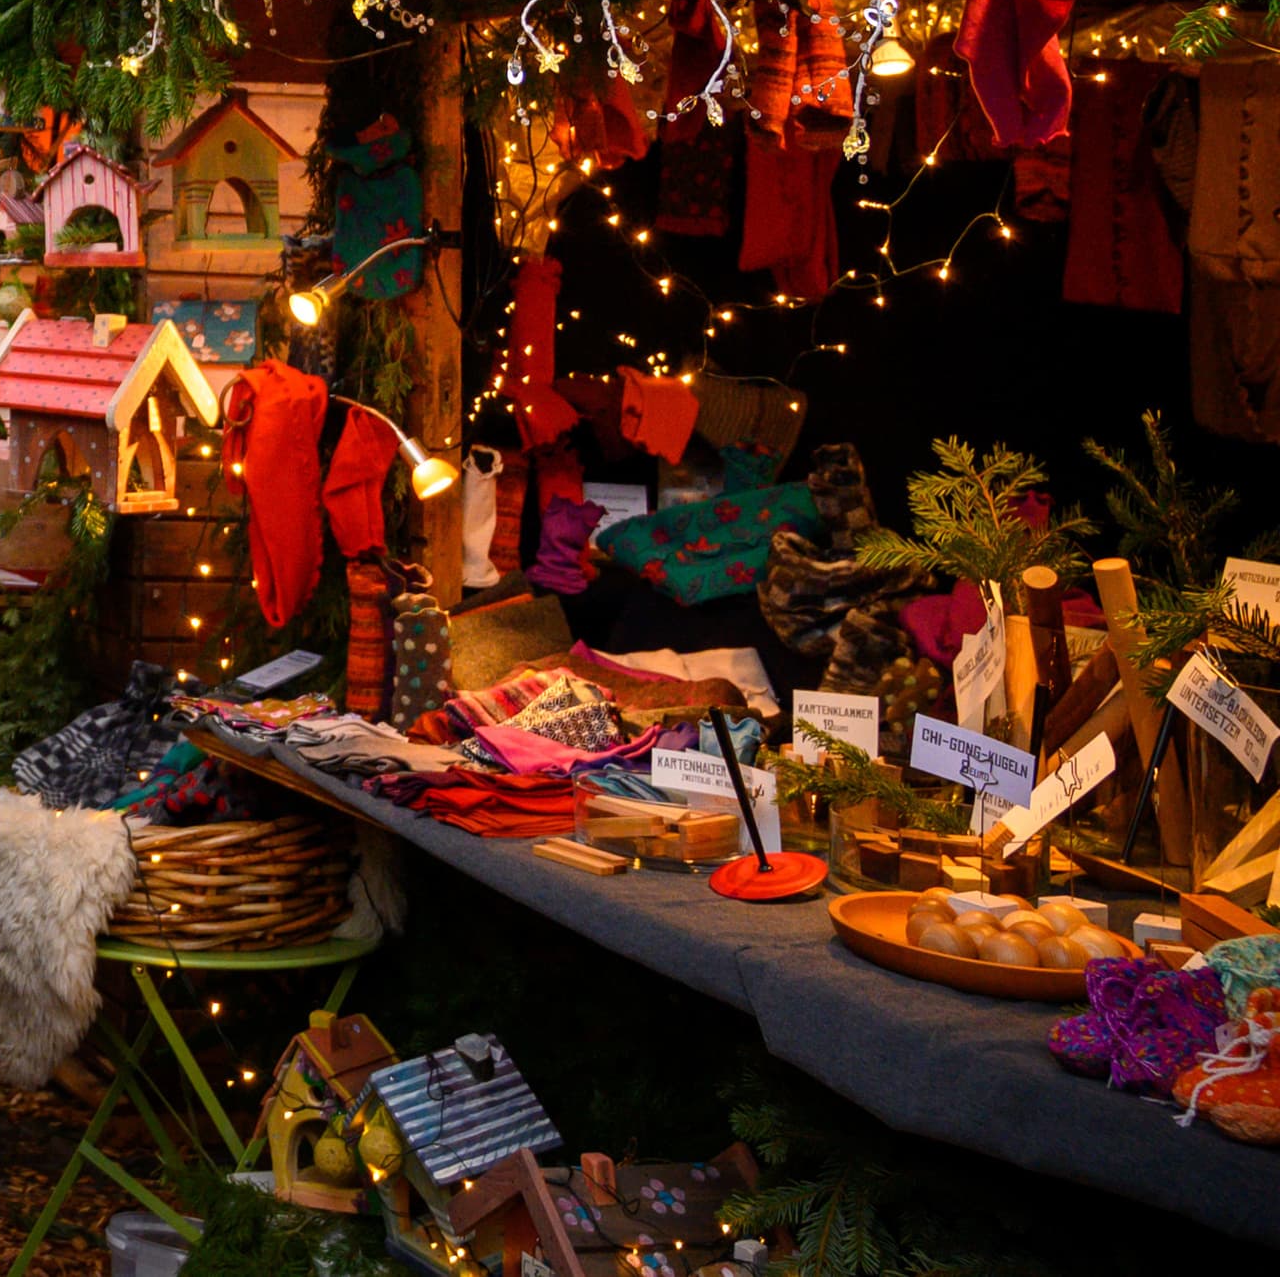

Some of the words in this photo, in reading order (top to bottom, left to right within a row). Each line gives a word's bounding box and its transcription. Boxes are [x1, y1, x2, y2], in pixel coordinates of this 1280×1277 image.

[798, 703, 873, 720] KARTENKLAMMER
[1180, 684, 1242, 740] UNTERSETZER
[657, 755, 728, 778] KARTENHALTER
[922, 727, 1028, 779] CHI-GONG-KUGELN
